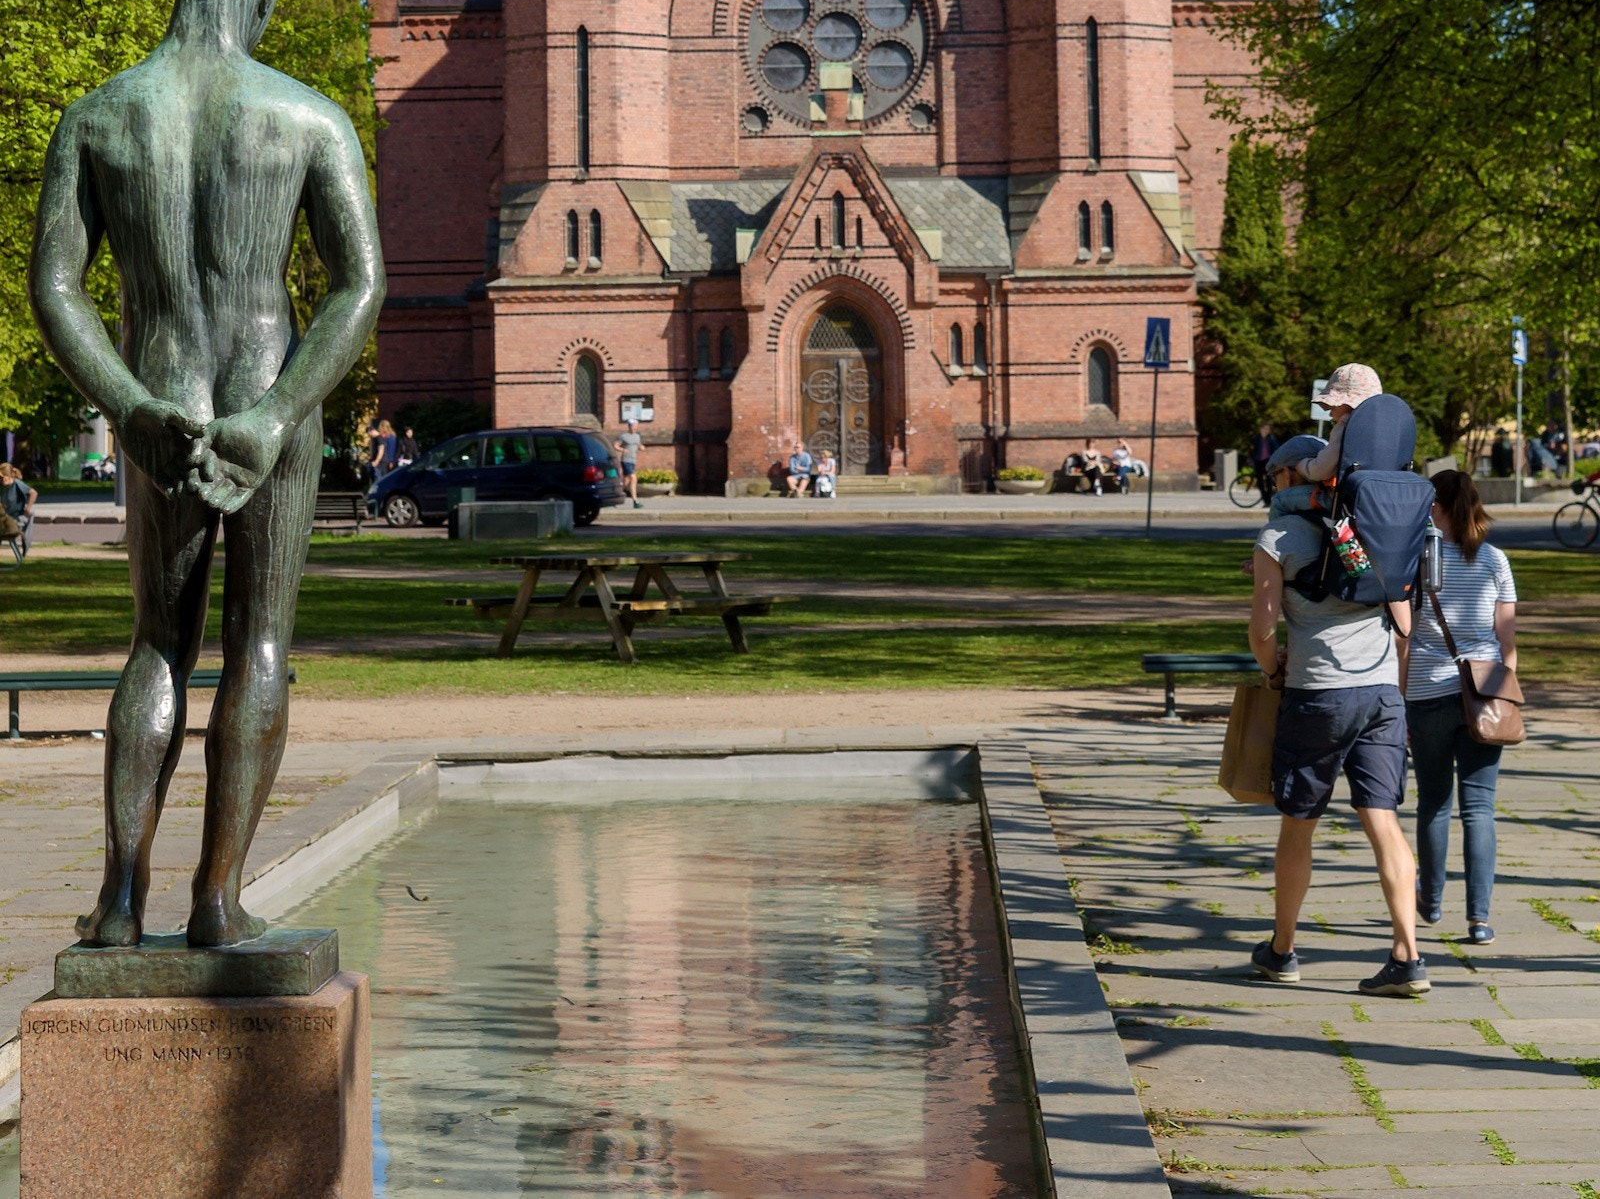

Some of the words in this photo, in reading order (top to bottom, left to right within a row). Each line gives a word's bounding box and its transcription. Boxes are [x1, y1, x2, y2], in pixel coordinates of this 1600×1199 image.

[97, 1017, 220, 1033] GUDMUNDSEN
[104, 1047, 142, 1062] UNG
[152, 1046, 202, 1062] MANN
